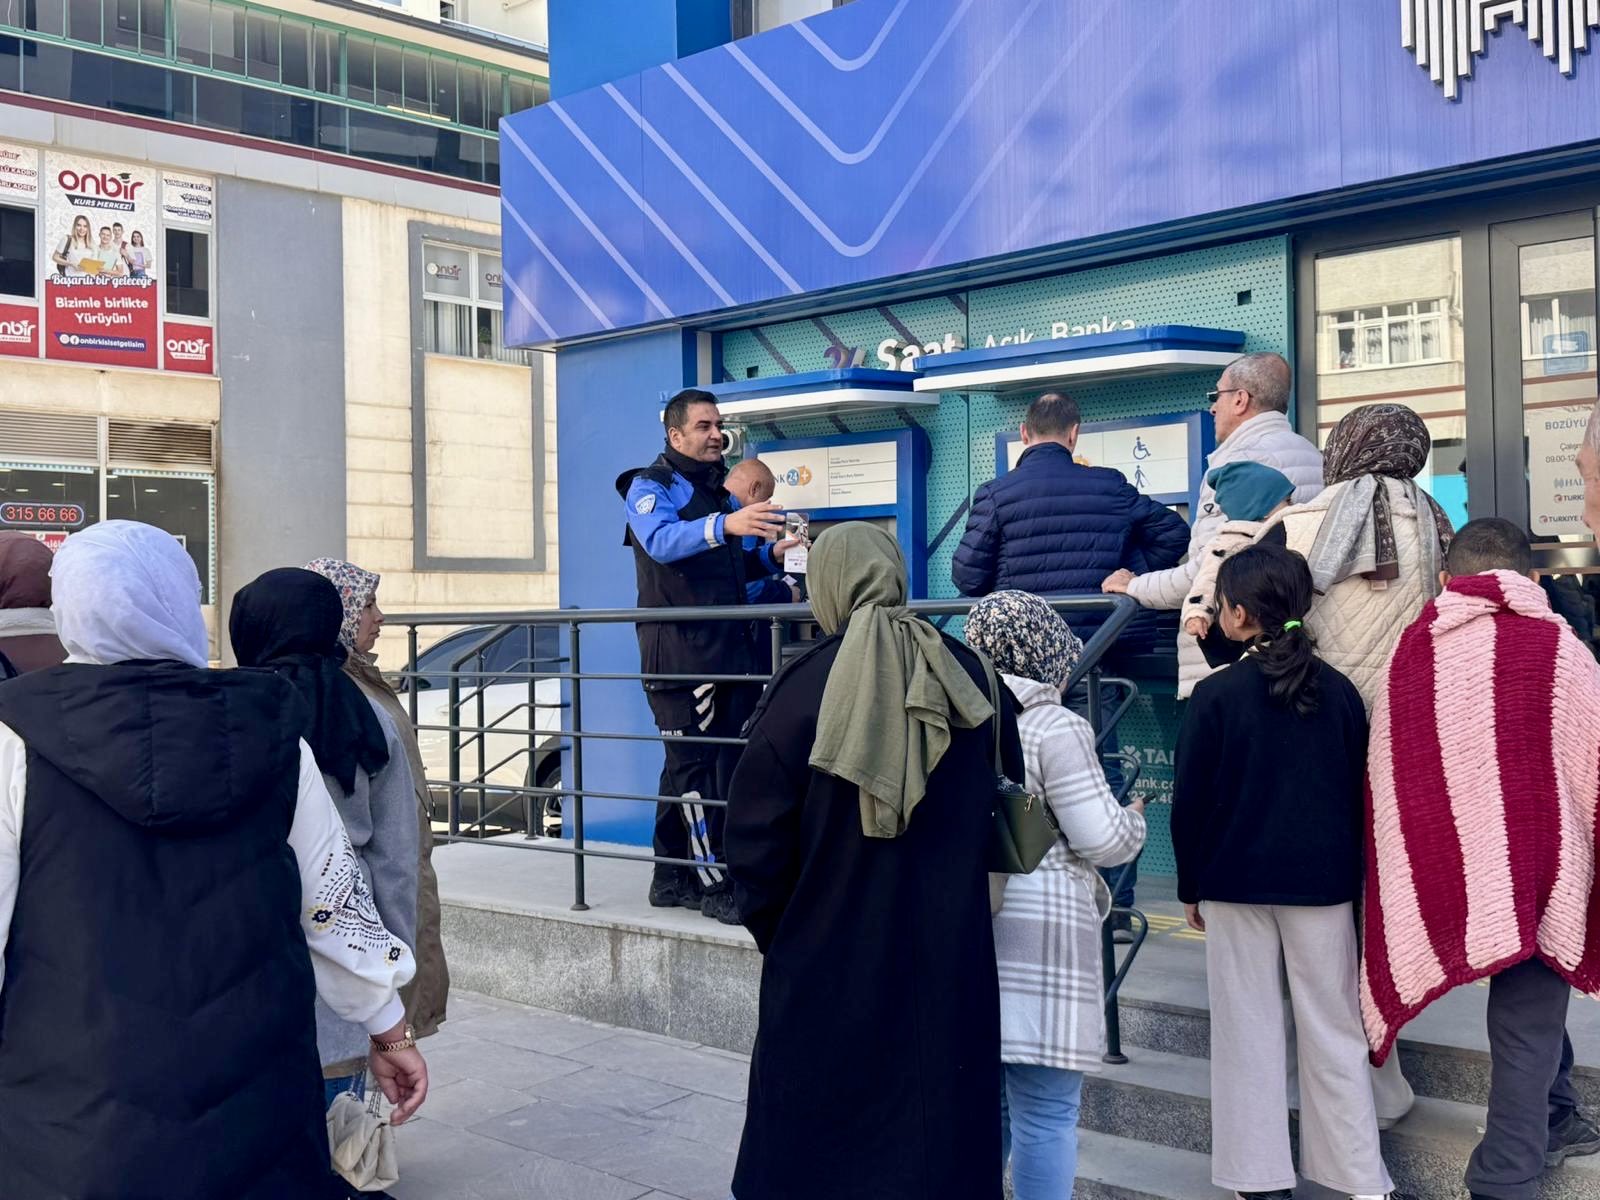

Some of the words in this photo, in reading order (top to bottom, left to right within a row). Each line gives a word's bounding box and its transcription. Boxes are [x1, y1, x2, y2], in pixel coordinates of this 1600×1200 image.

[58, 170, 144, 200] onbir
[73, 198, 96, 207] KURS
[97, 201, 132, 211] MERKEZİ
[436, 264, 461, 277] nbir
[95, 275, 111, 286] bir
[112, 275, 152, 289] geleceğe
[55, 297, 101, 308] Bizimle
[104, 297, 149, 308] birlikte
[74, 313, 132, 327] Yürüyün!
[0, 320, 36, 337] nbir
[166, 339, 211, 354] onbir
[1545, 418, 1586, 430] BOZÜYÜ
[6, 506, 34, 521] 315
[38, 507, 56, 521] 66
[60, 507, 78, 522] 66
[1143, 748, 1175, 765] TA
